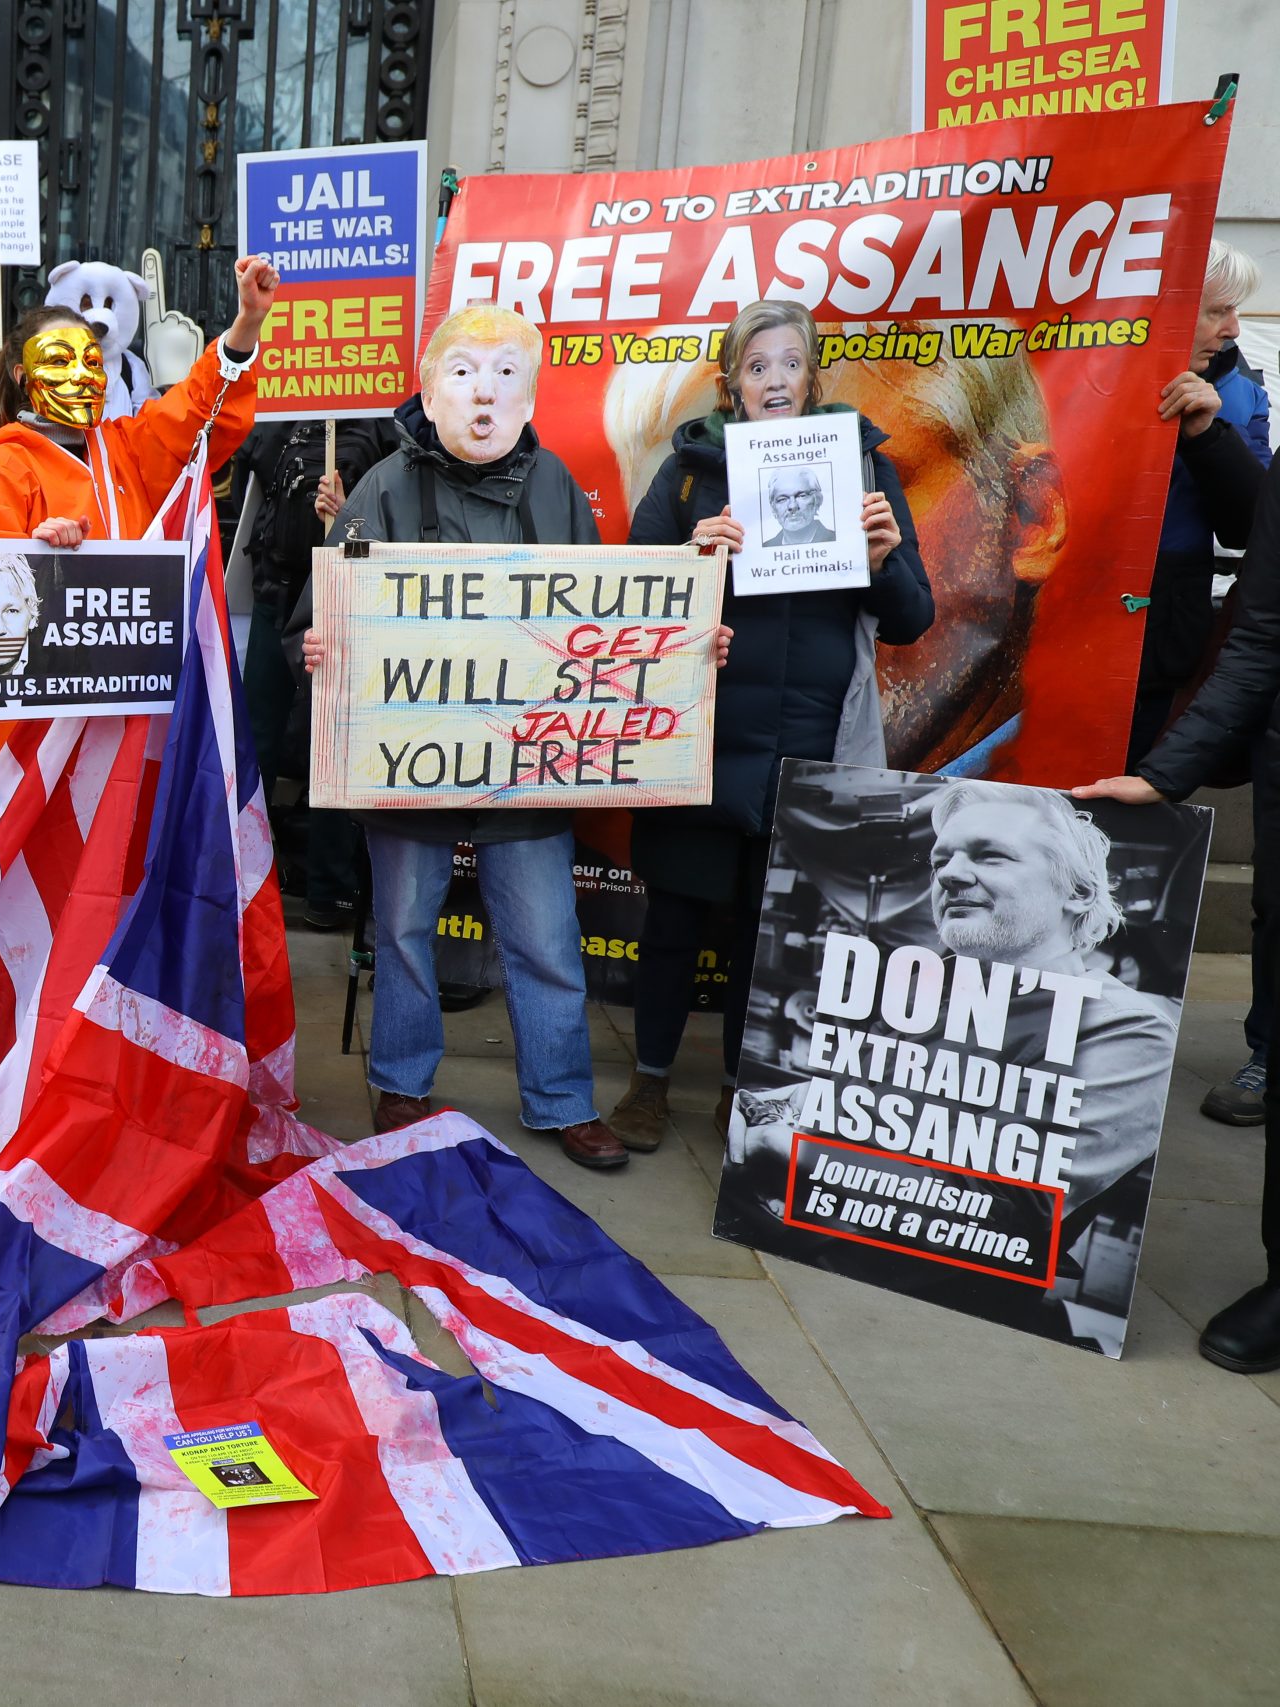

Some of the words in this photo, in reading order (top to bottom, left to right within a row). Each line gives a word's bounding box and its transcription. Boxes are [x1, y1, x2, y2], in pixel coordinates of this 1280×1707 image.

[943, 0, 1146, 61] FREE
[945, 41, 1141, 98] CHELSEA
[938, 77, 1147, 129] MANNING!
[5, 185, 15, 193] to
[12, 195, 25, 205] he
[277, 170, 385, 213] JAIL
[589, 199, 651, 229] NO
[661, 195, 717, 223] TO
[723, 155, 1053, 218] EXTRADITION!
[9, 207, 25, 216] liar
[0, 230, 27, 239] about
[270, 218, 324, 243] THE
[331, 215, 393, 239] WAR
[256, 243, 410, 272] CRIMINALS!
[449, 230, 673, 325] FREE
[686, 193, 1172, 318] ASSANGE
[260, 295, 403, 342] FREE
[262, 343, 400, 370] CHELSEA
[549, 334, 604, 367] 175
[609, 333, 701, 365] Years
[818, 322, 942, 369] posing
[949, 322, 1025, 360] War
[1026, 313, 1151, 352] Crimes
[257, 371, 405, 399] MANNING!
[749, 436, 793, 450] Frame
[796, 432, 839, 447] Julian
[762, 448, 828, 463] Assange!
[751, 565, 777, 578] War
[781, 560, 853, 577] Criminals!
[773, 549, 800, 562] Hail
[805, 547, 828, 559] the
[65, 587, 151, 617] FREE
[384, 572, 488, 620] THE
[508, 572, 694, 620] TRUTH
[42, 621, 174, 647] ASSANGE
[566, 623, 687, 659] GET
[6, 677, 42, 696] U.S.
[46, 674, 173, 695] EXTRADITION
[383, 658, 525, 706] WILL
[553, 658, 662, 705] SET
[511, 706, 676, 741] JAILED
[379, 742, 492, 788] YOU
[510, 739, 641, 787] FREE
[600, 881, 631, 893] Prison
[633, 884, 645, 895] 31
[608, 867, 632, 881] on
[815, 931, 1103, 1066] DON'T
[807, 1021, 1086, 1129] EXTRADITE
[798, 1076, 1077, 1194] ASSANGE
[809, 1154, 994, 1220] Journalism
[805, 1186, 835, 1217] is
[839, 1197, 898, 1232] not
[899, 1214, 922, 1238] a
[926, 1218, 1034, 1266] crime.
[176, 1438, 194, 1447] CAN
[194, 1434, 213, 1444] YOU
[216, 1431, 235, 1442] HELP
[236, 1430, 248, 1438] US
[181, 1447, 208, 1457] KIDNAP
[210, 1445, 225, 1453] AND
[227, 1440, 259, 1451] TORTURE
